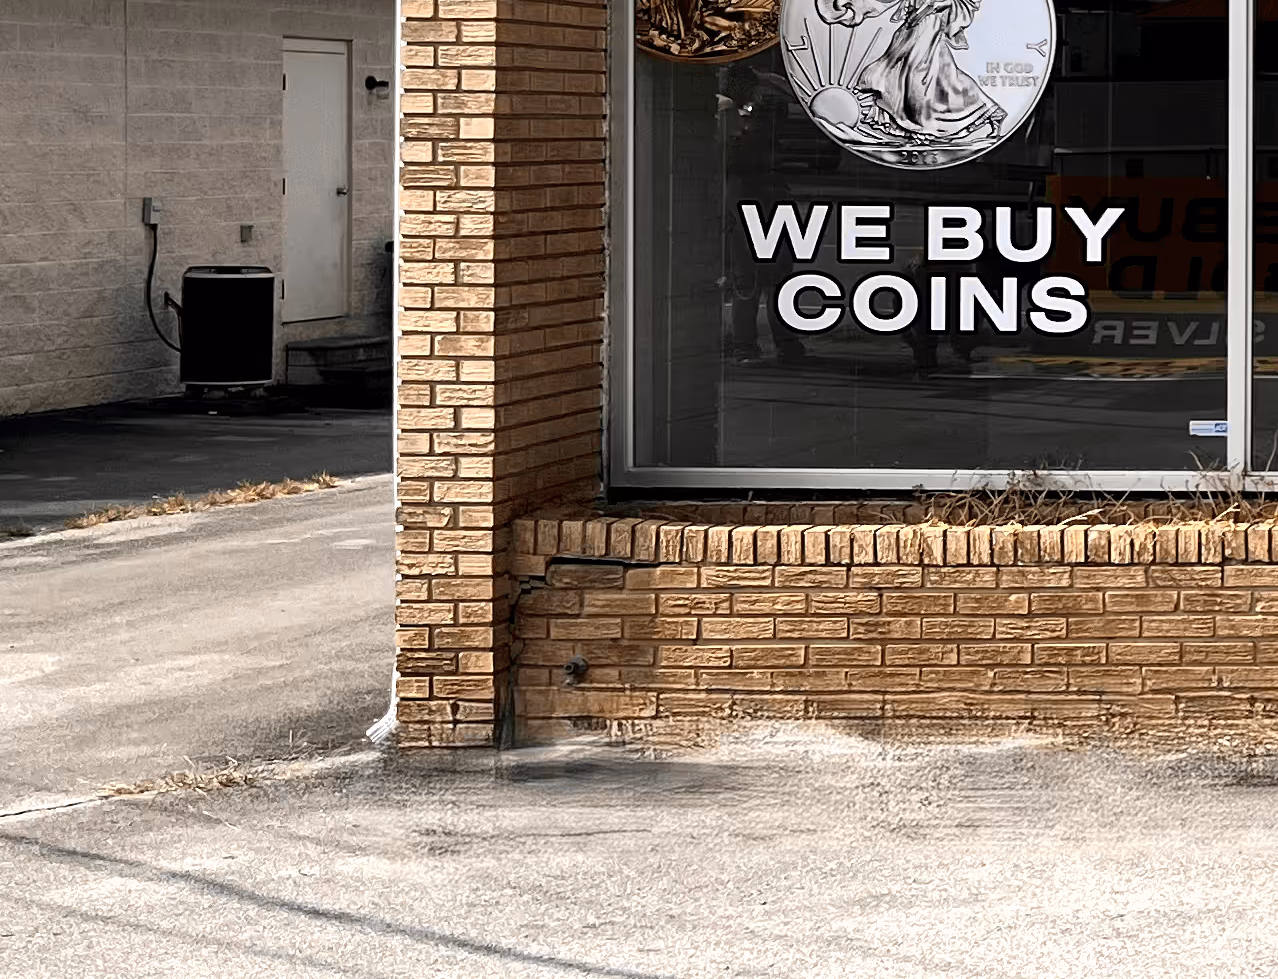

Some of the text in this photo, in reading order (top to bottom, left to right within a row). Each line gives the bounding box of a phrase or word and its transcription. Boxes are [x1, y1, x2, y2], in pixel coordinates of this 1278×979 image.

[977, 75, 1040, 87] WE TRUST
[986, 62, 1034, 73] IN GOD
[742, 205, 1125, 262] WE BUY
[777, 275, 1089, 333] COINS
